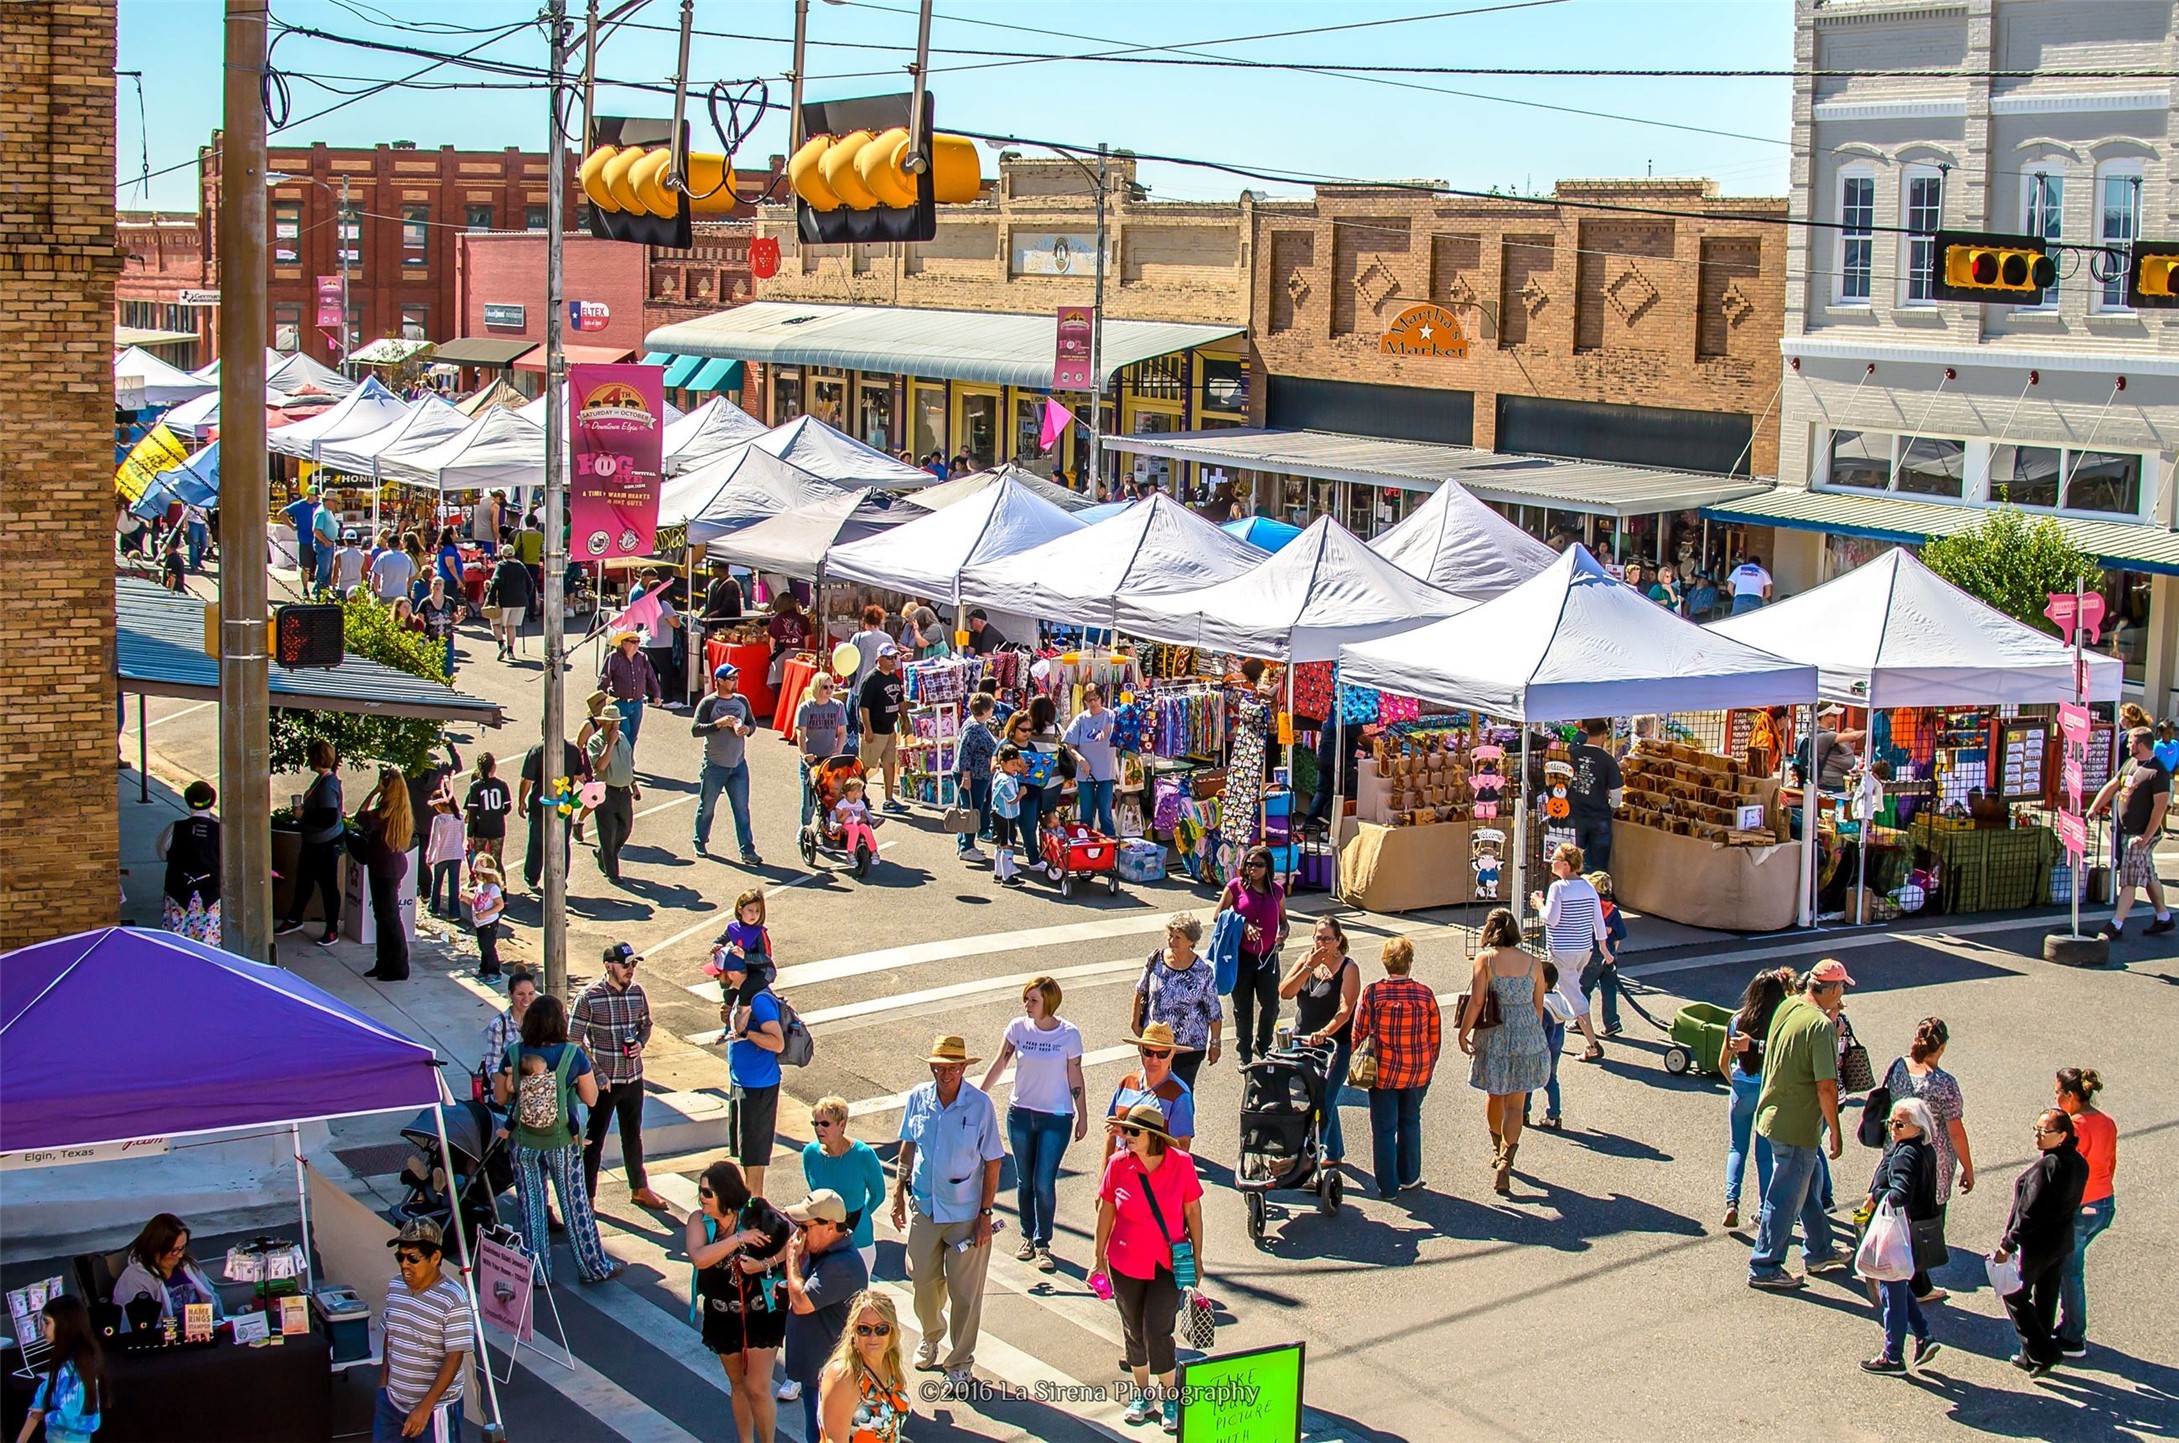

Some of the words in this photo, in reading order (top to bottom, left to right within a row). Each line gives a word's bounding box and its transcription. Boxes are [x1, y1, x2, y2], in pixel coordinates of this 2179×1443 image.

[581, 307, 605, 316] ELTEX
[1391, 308, 1460, 339] Martha's
[1384, 341, 1464, 357] Market
[601, 387, 631, 407] 4TH
[582, 410, 613, 419] SATURDAY
[620, 410, 650, 420] OCTOBER
[591, 421, 620, 430] Downtown
[621, 421, 638, 433] Elgin
[576, 453, 634, 476] HOG
[341, 475, 374, 483] HONE
[480, 788, 502, 811] 10
[24, 1152, 56, 1163] Elgin,
[61, 1148, 94, 1158] Texas
[188, 1308, 209, 1316] NAME
[188, 1314, 211, 1323] RINGS
[1215, 1400, 1272, 1431] PICTURE
